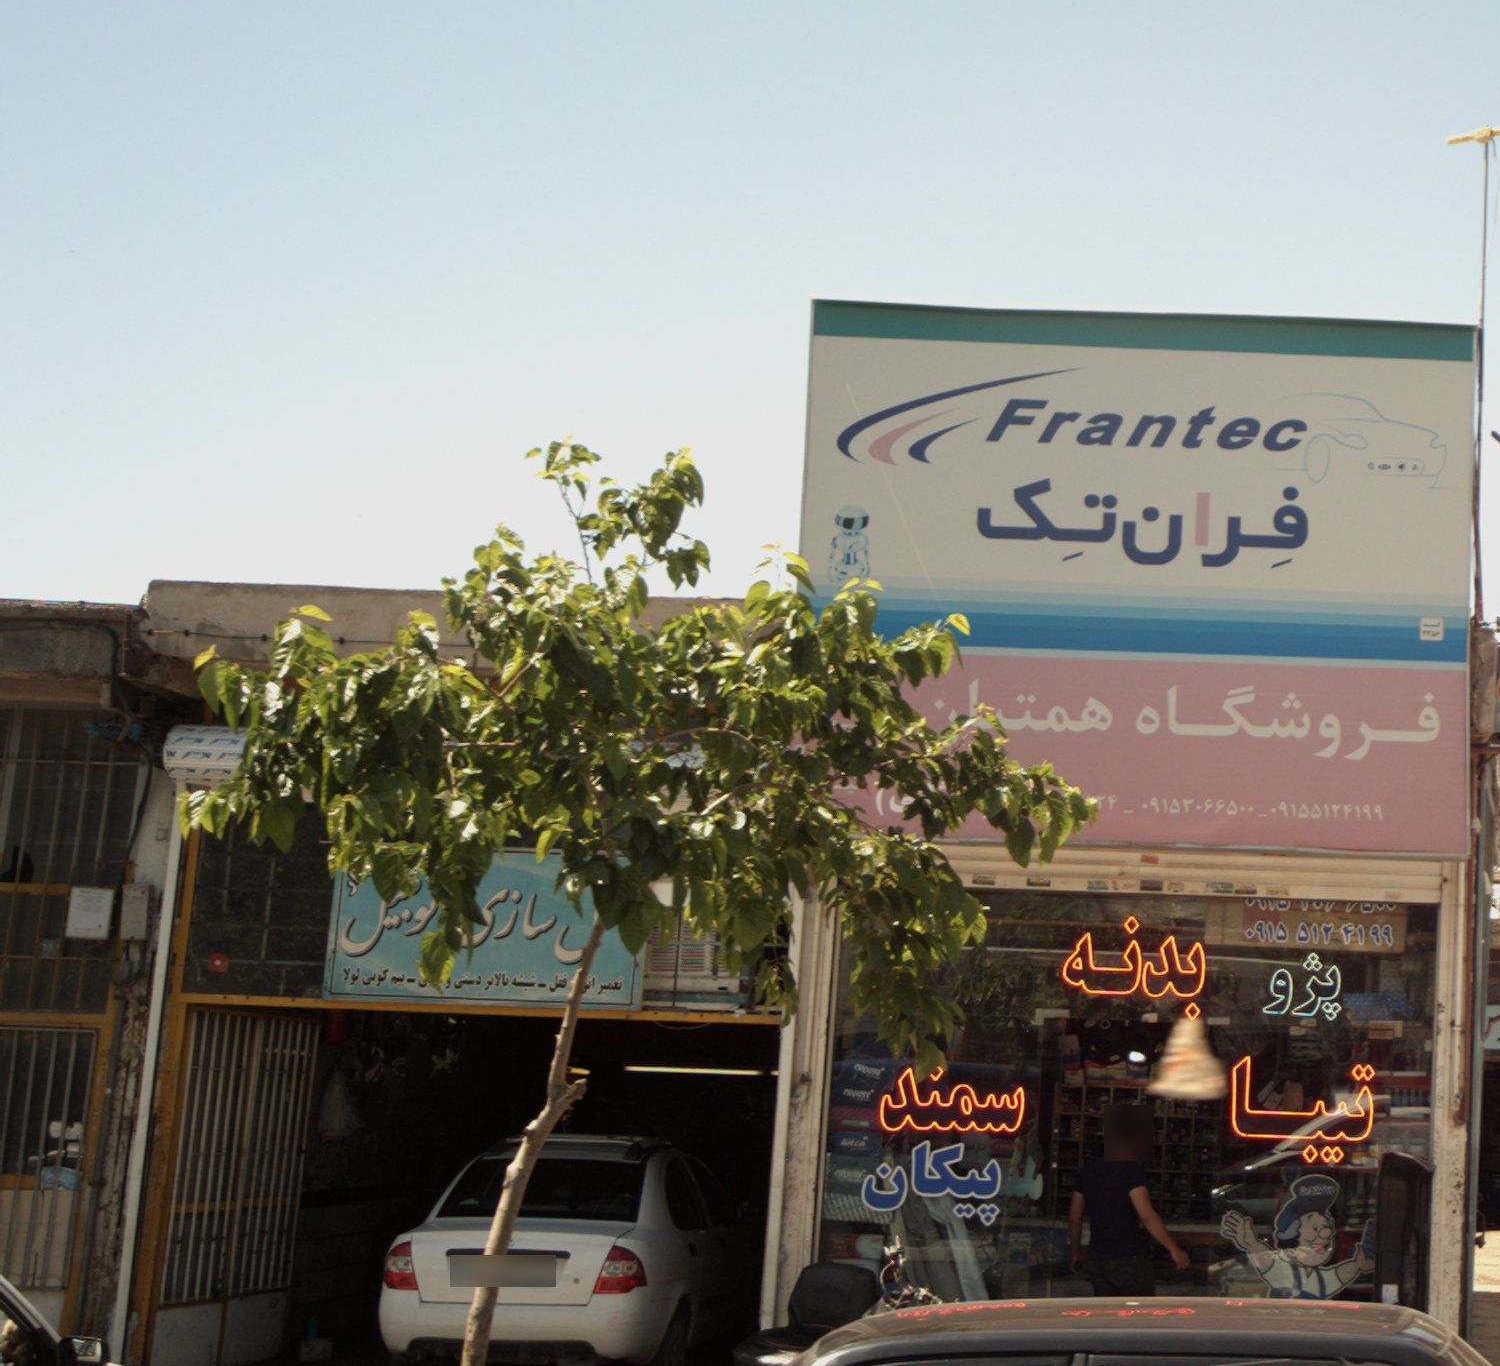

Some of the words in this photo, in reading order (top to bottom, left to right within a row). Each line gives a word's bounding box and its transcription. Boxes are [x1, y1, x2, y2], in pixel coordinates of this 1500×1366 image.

[985, 398, 1309, 452] Frantec
[1135, 684, 1441, 761] فروشگاه
[1061, 916, 1206, 1020] بدنه
[1244, 919, 1290, 943] ۰۹۱۵
[1296, 921, 1334, 944] ۵۱۲
[1340, 922, 1393, 946] ۴۱۹۹
[1263, 952, 1343, 1021] پژو
[879, 1066, 1026, 1133] سمند
[1231, 1055, 1376, 1163] تیبا
[861, 1139, 1002, 1225] پیکان
